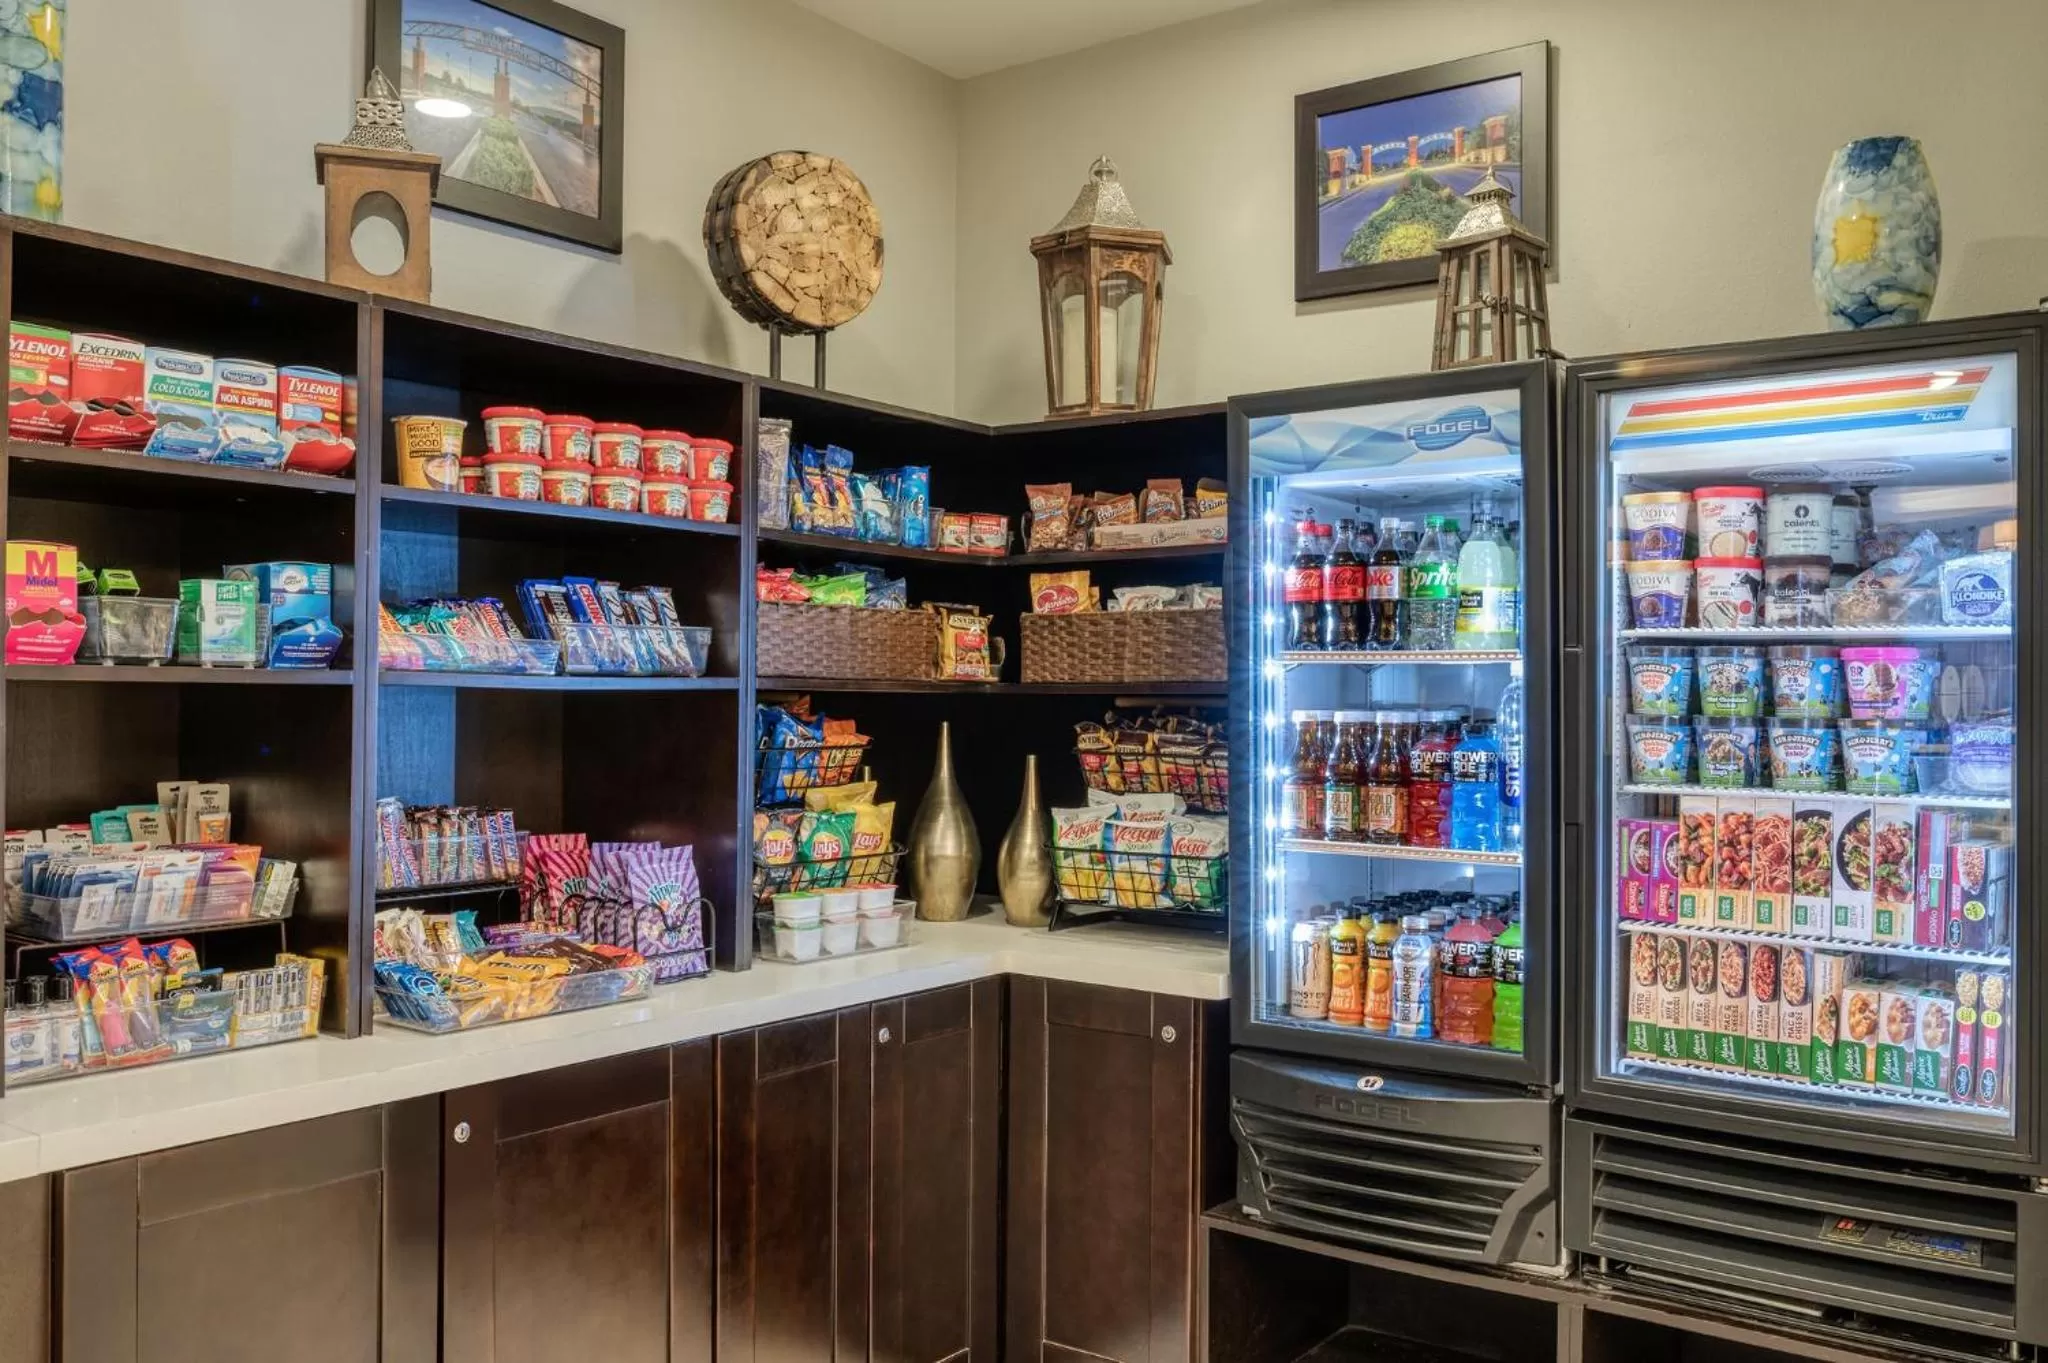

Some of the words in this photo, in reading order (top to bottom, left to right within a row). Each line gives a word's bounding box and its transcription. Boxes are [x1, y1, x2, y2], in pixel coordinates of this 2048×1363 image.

[9, 338, 68, 357] YLENOL
[79, 342, 140, 360] EXCEDRIN
[153, 382, 175, 394] COLD
[183, 386, 210, 399] COUGH
[288, 377, 339, 397] TYLENOL
[220, 392, 239, 404] NON
[240, 396, 273, 408] ASPIRIN
[1409, 419, 1489, 438] FOGEL
[410, 439, 440, 448] GOOD
[1784, 519, 1819, 528] talenti
[1410, 566, 1460, 587] Sprite
[1723, 1012, 1731, 1031] MAC
[1731, 1004, 1739, 1032] CHEESE
[1756, 1004, 1764, 1037] LASAGNA
[1794, 1011, 1803, 1040] CHEESE
